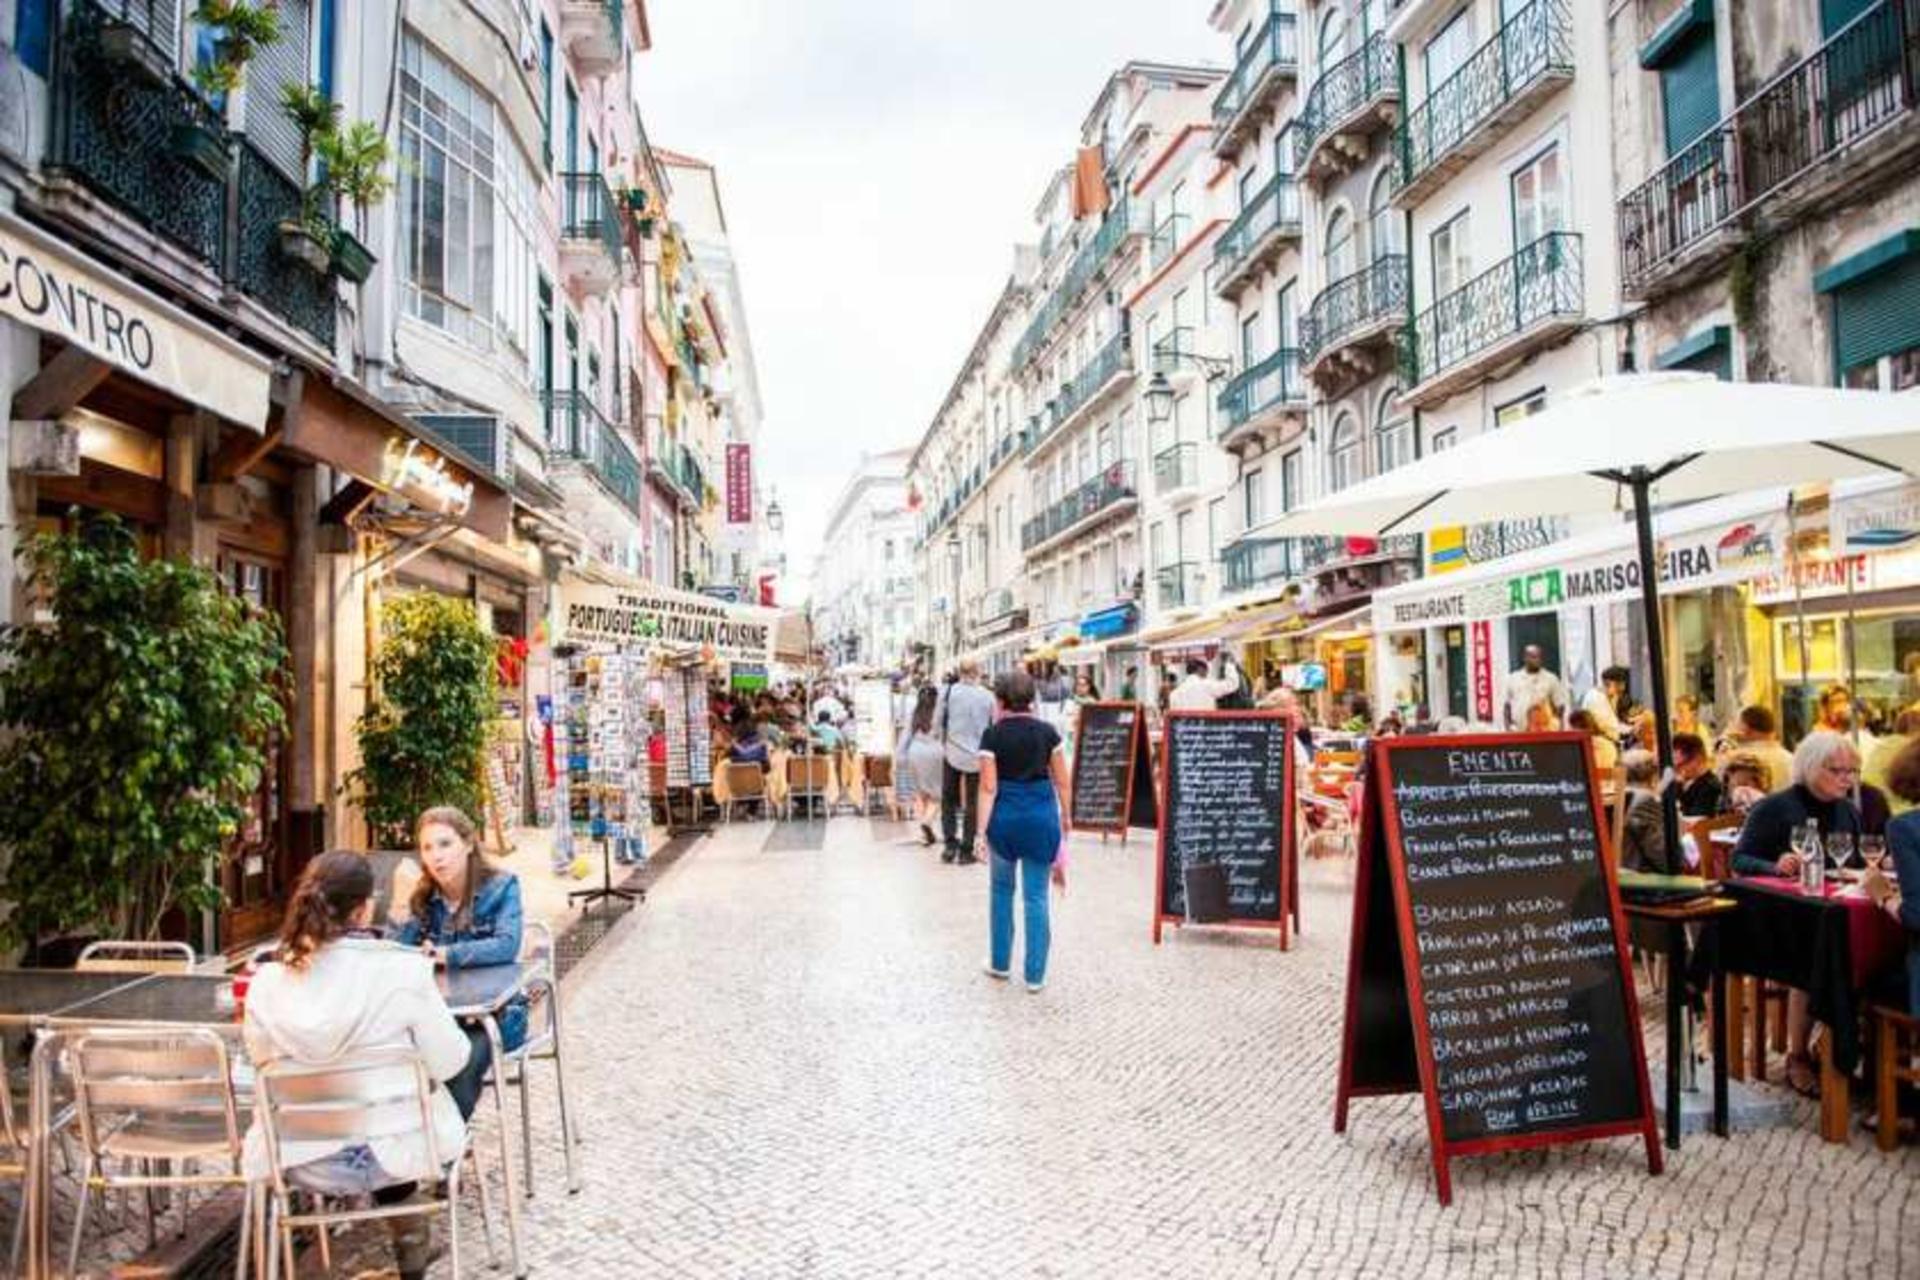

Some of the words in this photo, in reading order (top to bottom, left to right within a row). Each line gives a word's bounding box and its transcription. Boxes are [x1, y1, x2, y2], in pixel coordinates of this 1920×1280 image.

[1393, 595, 1465, 623] RESTAURANTE
[1567, 545, 1712, 599] MARISQEIRA
[1753, 553, 1867, 596] RESTAURANTE
[617, 594, 728, 619] TRADITIONAL
[665, 616, 714, 643] ITALIAN
[716, 621, 768, 650] CUISINE
[1448, 751, 1533, 776] EMENTA
[1414, 903, 1496, 926] BACALHAU
[1506, 896, 1565, 915] ASSADO
[1429, 1008, 1480, 1030] ARROZ
[1430, 1031, 1510, 1062] BACALHAU
